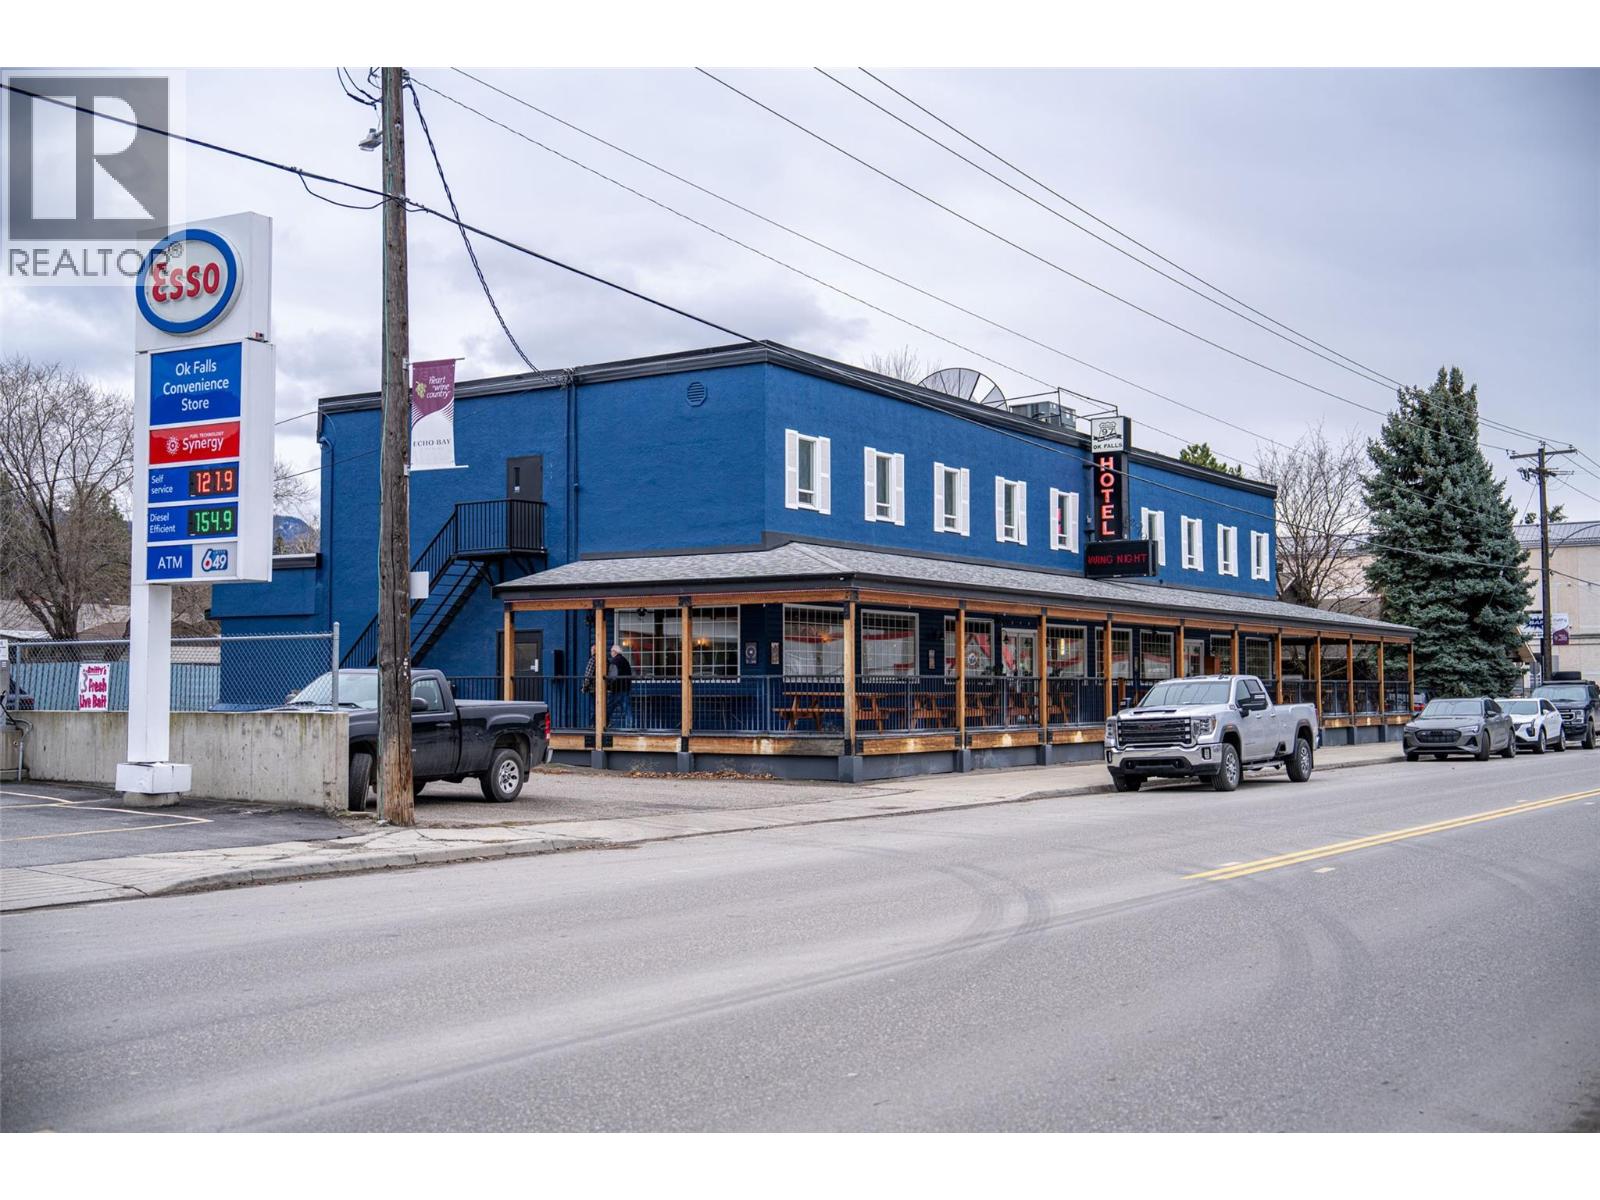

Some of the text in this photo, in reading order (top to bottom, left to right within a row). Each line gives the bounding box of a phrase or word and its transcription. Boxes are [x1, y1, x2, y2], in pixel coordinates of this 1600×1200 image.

[175, 359, 217, 376] Ok Falls
[163, 378, 230, 396] Convenience
[181, 398, 209, 411] Store
[182, 437, 224, 454] Synergy
[413, 438, 451, 448] ECHO BAY
[151, 474, 164, 485] Self
[151, 485, 174, 495] service
[1100, 456, 1115, 535] HOTEL
[150, 512, 170, 522] Diesel
[149, 524, 176, 534] Efficient
[157, 556, 183, 570] ATM
[1087, 553, 1148, 566] WING NIGHT
